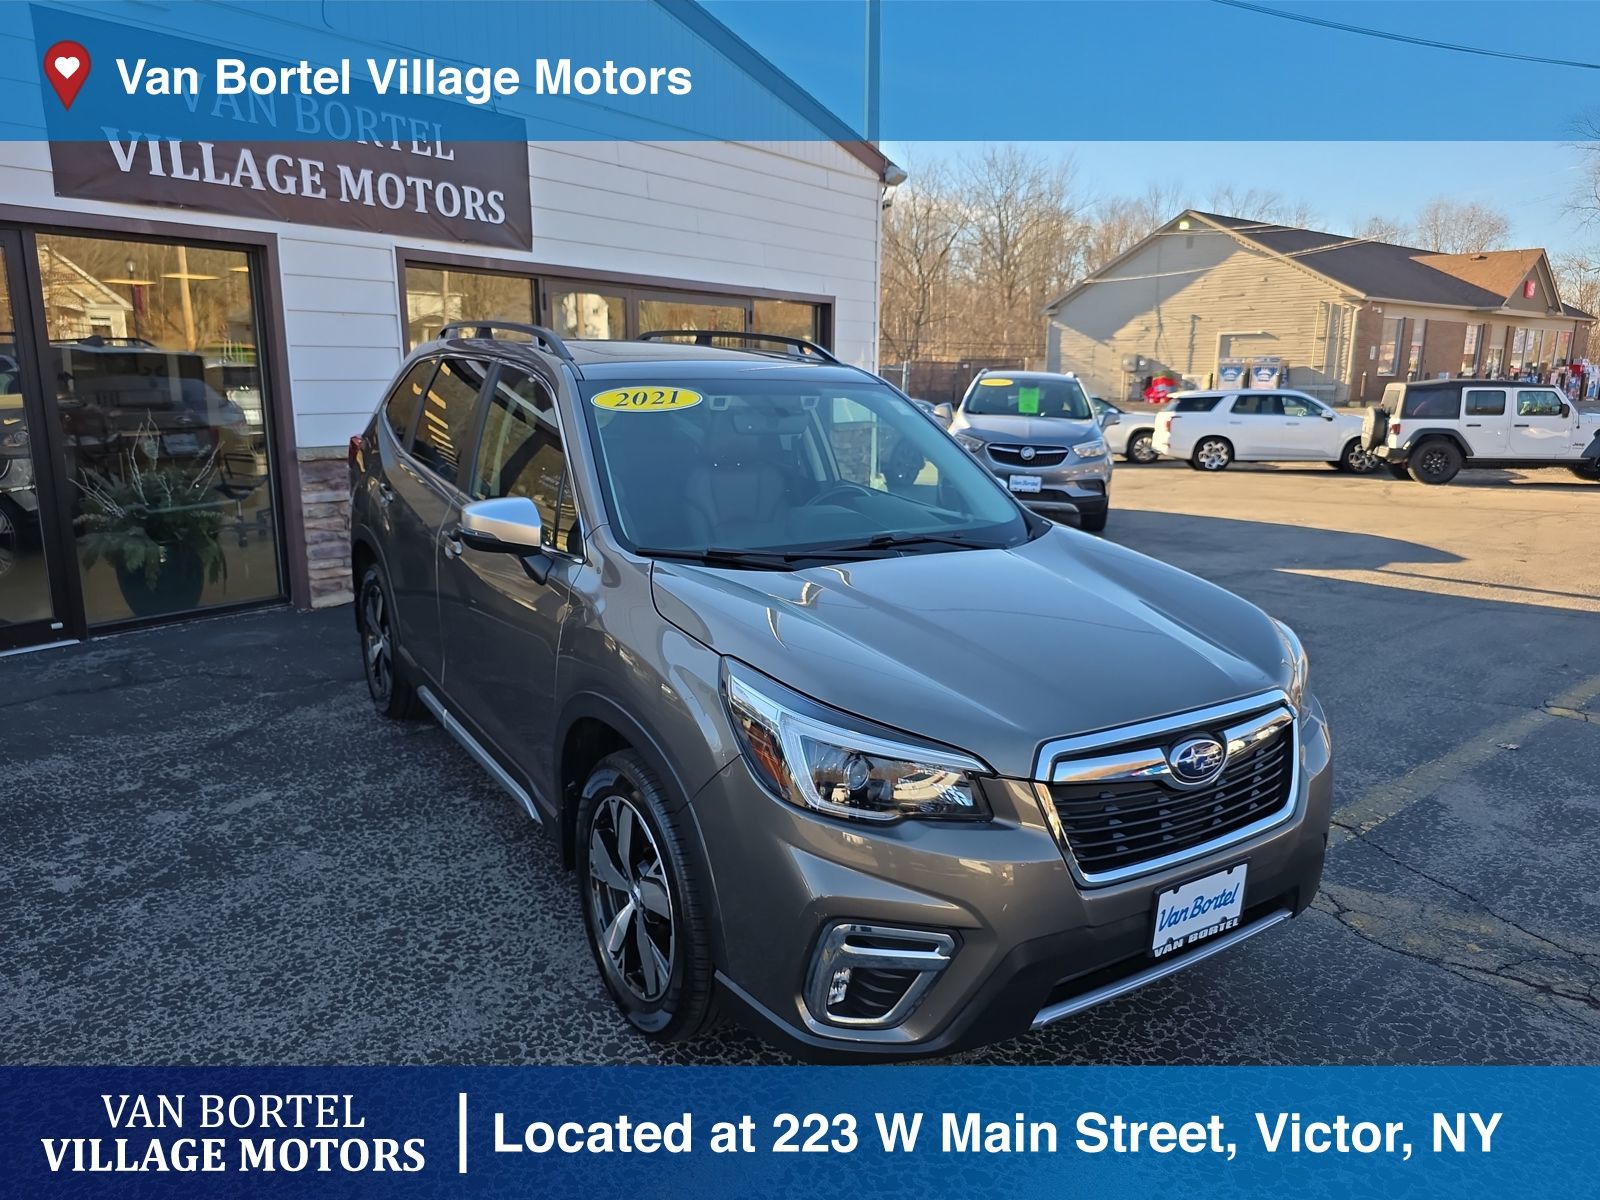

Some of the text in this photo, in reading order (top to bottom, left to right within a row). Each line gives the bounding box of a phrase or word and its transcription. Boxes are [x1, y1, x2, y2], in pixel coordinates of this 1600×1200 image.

[294, 91, 456, 161] BORTEL
[101, 126, 507, 225] VILLAGE MOTORS
[614, 390, 680, 407] 2021
[1158, 882, 1241, 932] Van Bortel
[1153, 917, 1240, 958] VAN BORTEL
